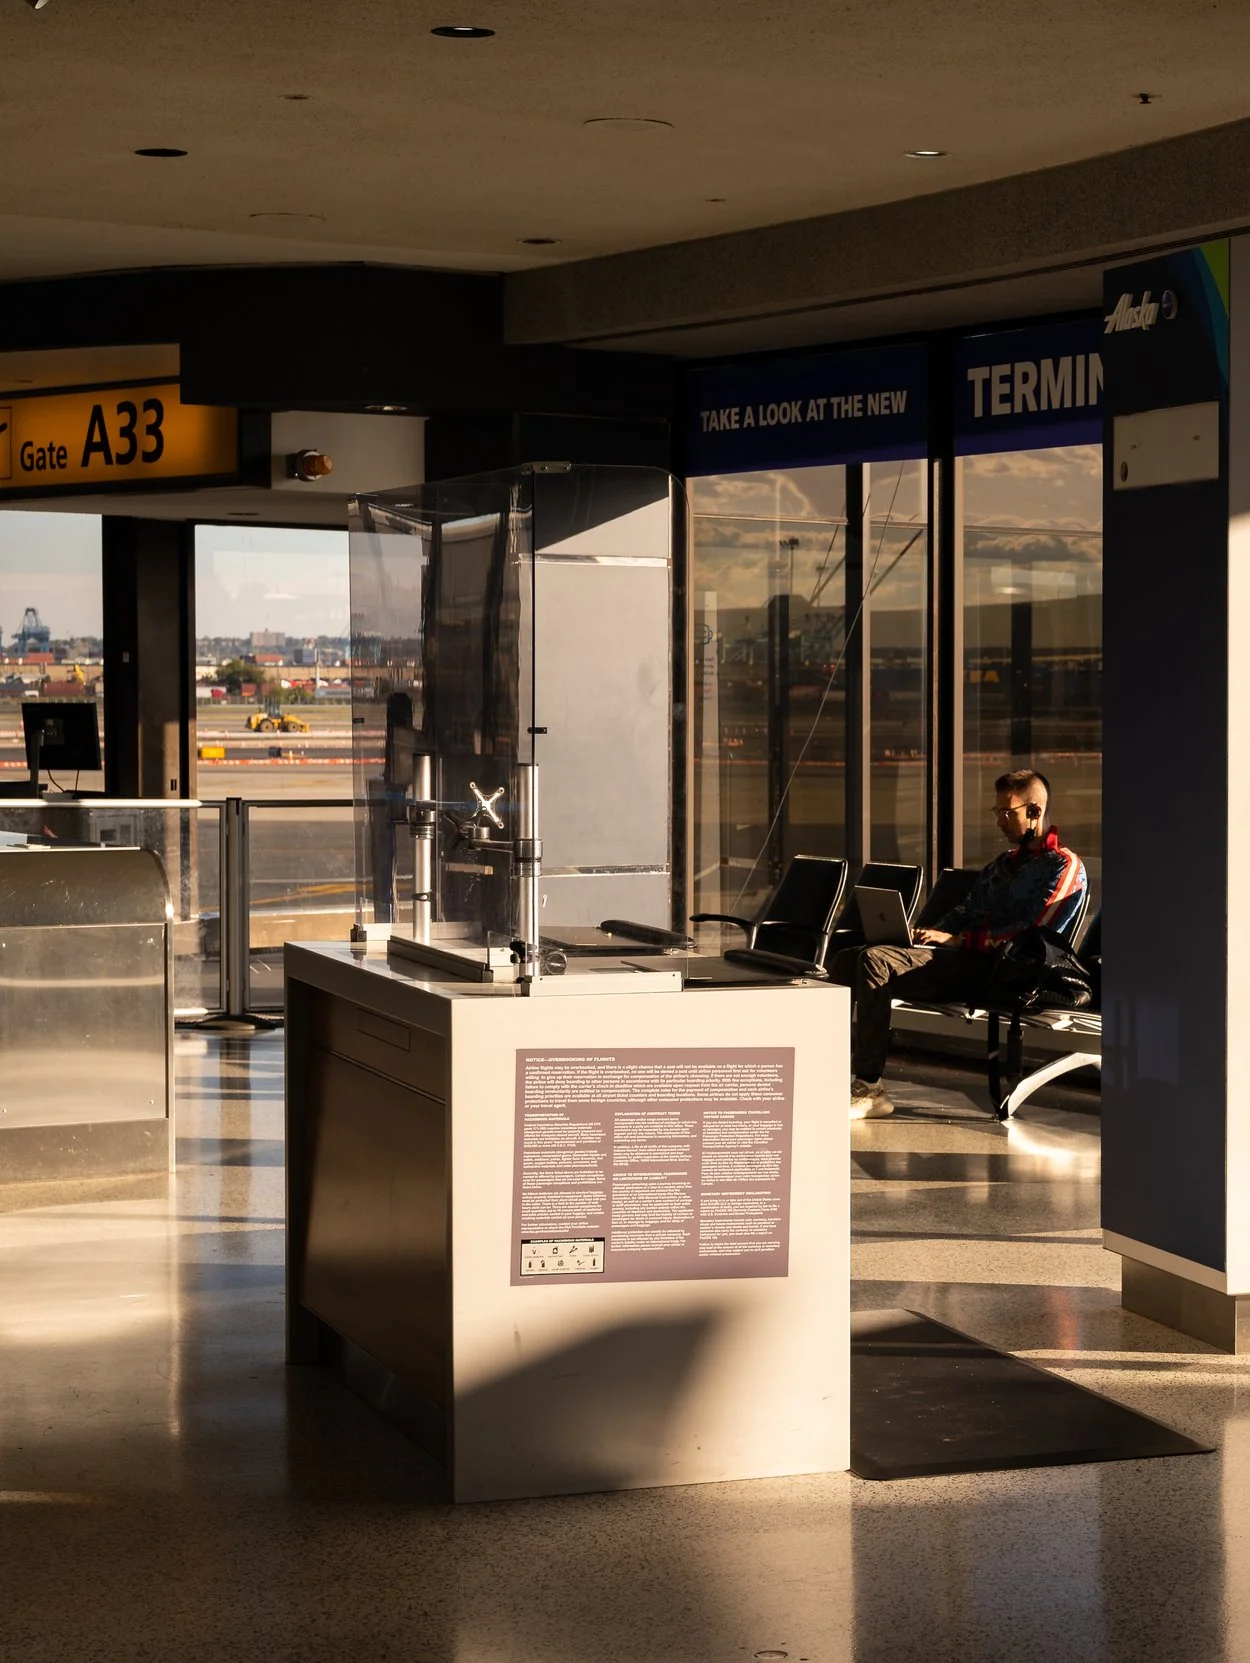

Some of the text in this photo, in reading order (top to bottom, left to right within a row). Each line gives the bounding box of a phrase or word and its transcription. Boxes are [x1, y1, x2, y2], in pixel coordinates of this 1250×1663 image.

[1104, 291, 1159, 334] Alaska
[700, 390, 907, 432] TAKE A LOOK AT THE NEW
[20, 398, 165, 472] Gate A33
